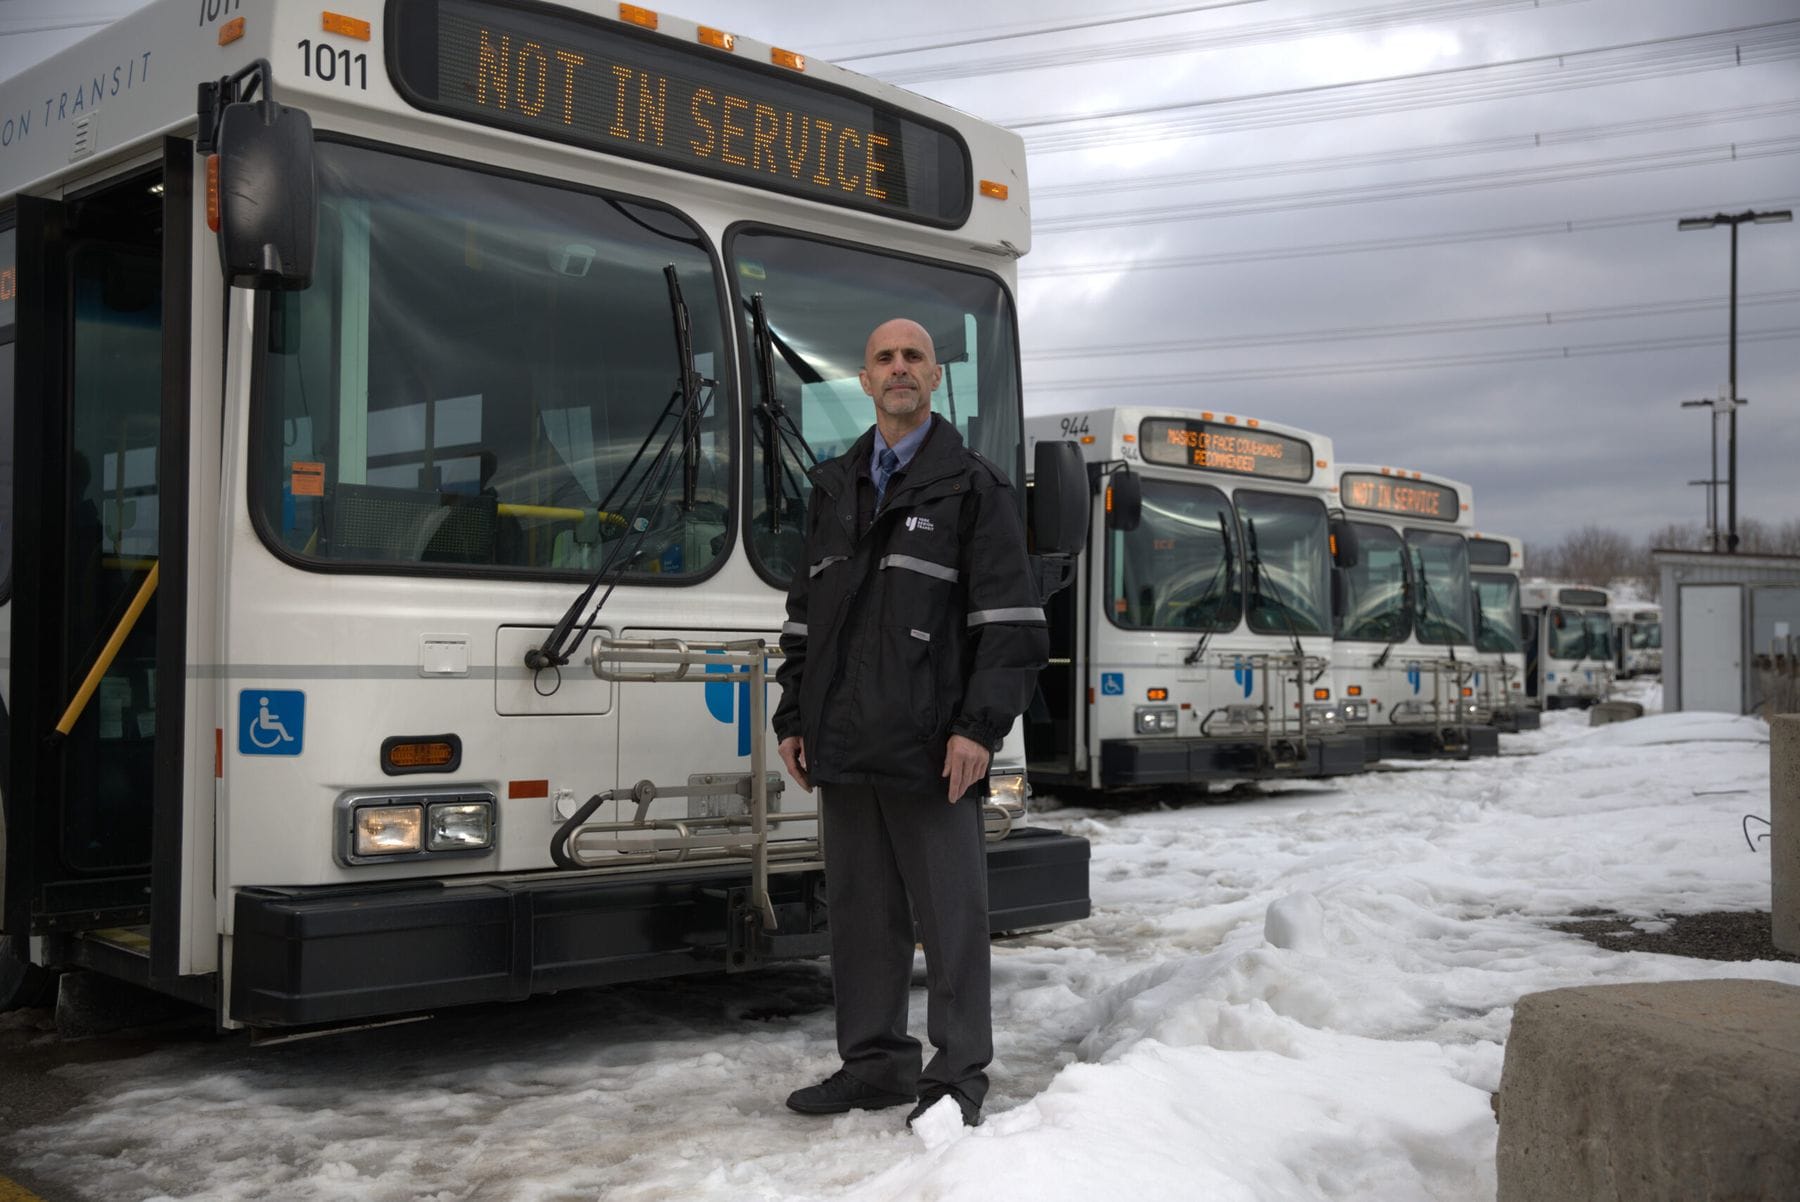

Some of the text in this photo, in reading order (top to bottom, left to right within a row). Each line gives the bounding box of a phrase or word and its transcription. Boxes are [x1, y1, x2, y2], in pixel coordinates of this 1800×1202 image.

[199, 0, 239, 27] 10
[298, 39, 367, 90] 1011
[2, 51, 151, 146] ON TRANSIT
[477, 29, 888, 201] NOT IN SERVICE
[1060, 416, 1089, 437] 944
[1167, 428, 1198, 448] MASKS
[1199, 432, 1211, 449] OR
[1212, 434, 1235, 452] FACE
[1121, 446, 1138, 460] 944
[1352, 481, 1440, 515] NOT IN SERVICE
